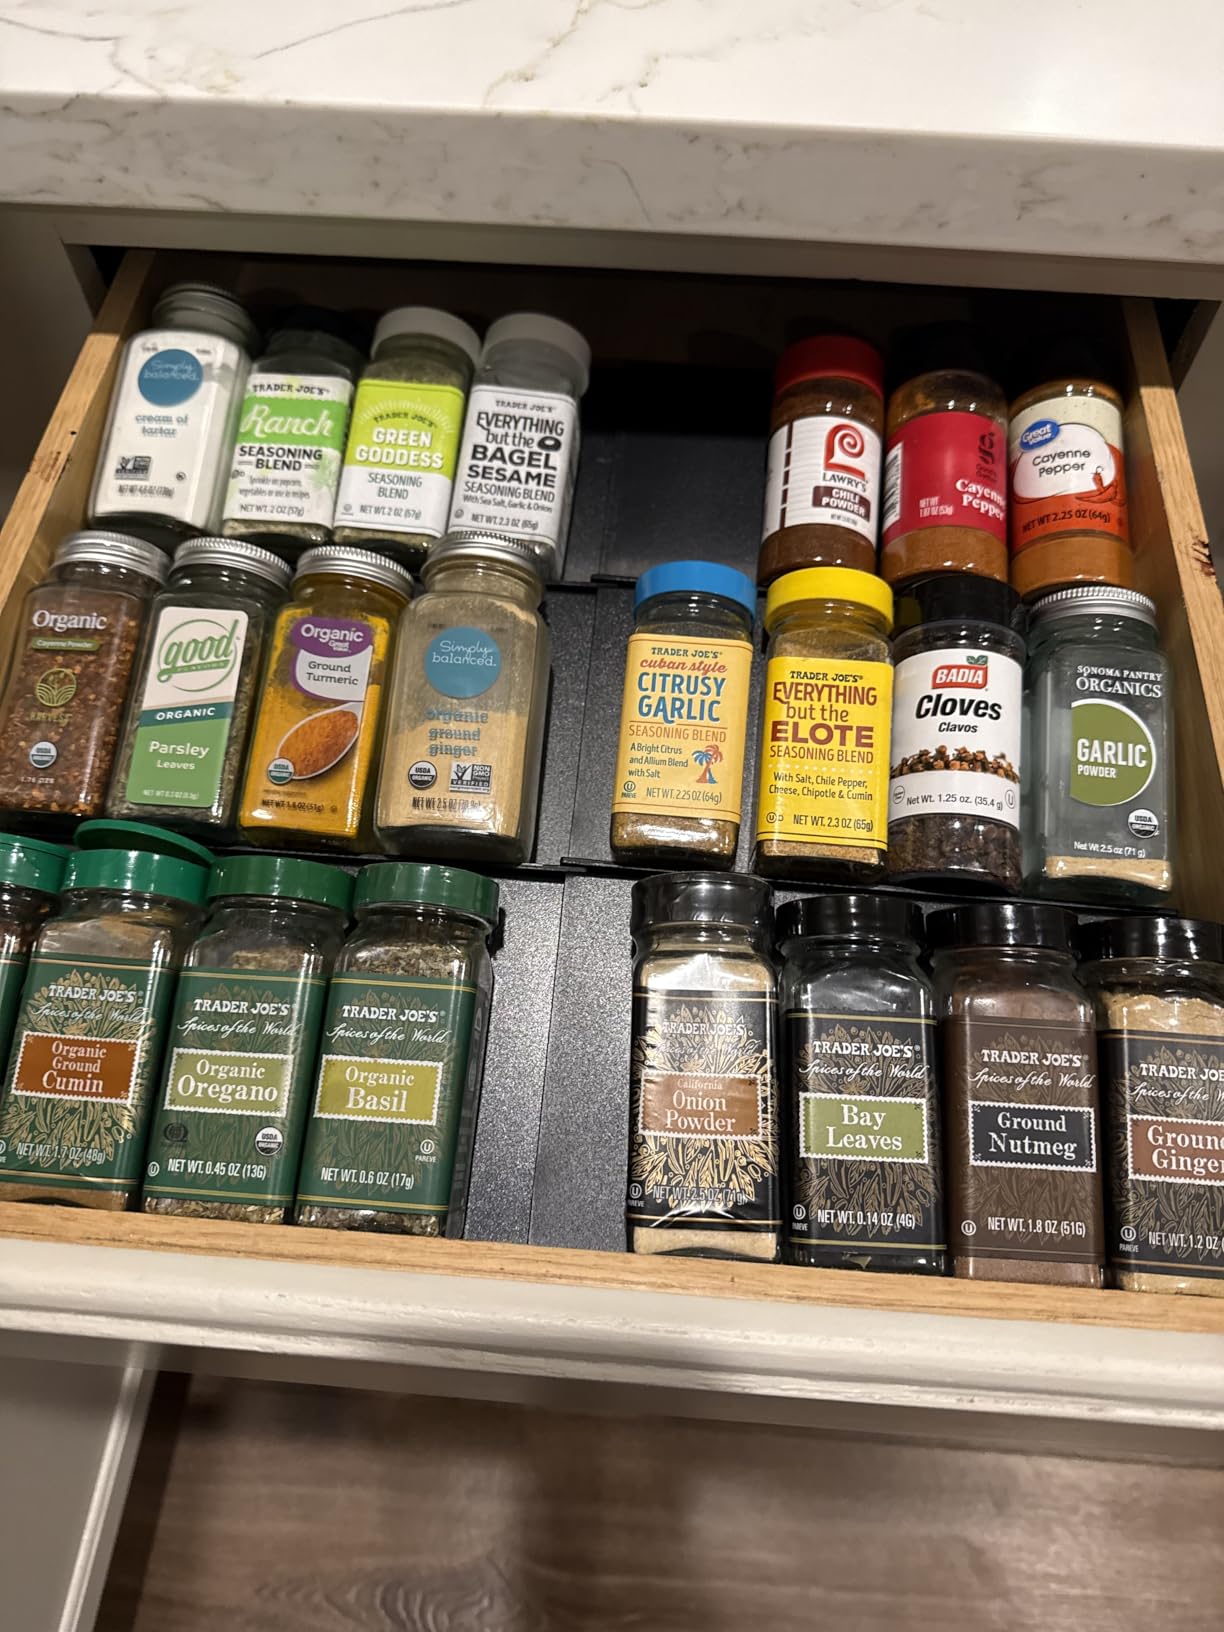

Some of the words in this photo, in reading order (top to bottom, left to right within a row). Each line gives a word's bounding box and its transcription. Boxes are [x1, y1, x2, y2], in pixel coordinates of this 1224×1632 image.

[253, 384, 293, 392] TRADER
[296, 385, 324, 395] JOE'S
[136, 415, 172, 424] cream
[176, 414, 188, 424] of
[240, 405, 334, 438] Ranch
[477, 412, 564, 436] EVERYTHING
[142, 427, 176, 437] tartar
[372, 428, 432, 448] GREEN
[486, 428, 510, 445] but
[512, 433, 534, 448] the
[240, 446, 322, 460] SEASONING
[356, 446, 444, 469] GODDESS
[472, 444, 557, 471] BAGEL
[1032, 449, 1090, 466] Cayenne
[256, 459, 302, 471] BLEND
[1039, 463, 1086, 478] Pepper
[368, 472, 422, 487] SEASONING
[468, 464, 556, 488] SESAME
[823, 472, 866, 492] LAWRY'S
[378, 487, 408, 499] BLEND
[464, 481, 521, 498] SEASONING
[523, 489, 555, 502] BLEND
[832, 488, 859, 502] CHILI
[822, 497, 866, 516] POWDER
[1024, 521, 1038, 532] NET
[1038, 514, 1051, 526] WT
[1052, 510, 1072, 521] 2.25
[1076, 510, 1086, 518] OZ
[1089, 511, 1110, 523] (64g)
[32, 609, 107, 632] Organic
[301, 623, 364, 643] Organic
[157, 618, 238, 683] good
[440, 640, 493, 658] Simply
[651, 647, 688, 657] TRADER
[691, 650, 719, 658] JOE'S
[308, 661, 351, 673] Ground
[432, 652, 496, 666] balanced.
[640, 658, 688, 670] cuban
[688, 660, 727, 676] style
[306, 672, 358, 685] Turmeric
[790, 671, 828, 680] TRADER
[832, 673, 858, 682] JOE'S
[936, 668, 983, 684] BADIA
[1077, 665, 1121, 677] SONOMA
[1123, 670, 1162, 681] PANTRY
[637, 672, 726, 697] CITRUSY
[773, 682, 877, 705] EVERYTHING
[1076, 676, 1162, 697] ORGANICS
[156, 707, 215, 720] ORGANIC
[424, 708, 489, 724] organic
[638, 695, 721, 724] GARLIC
[786, 701, 816, 720] but
[819, 704, 849, 722] the
[915, 694, 1002, 720] Cloves
[429, 728, 480, 741] ground
[629, 725, 689, 740] SEASONING
[692, 729, 726, 743] BLEND
[771, 721, 874, 748] ELOTE
[938, 722, 978, 733] Clavos
[150, 741, 209, 759] Parsley
[429, 743, 477, 758] ginger
[631, 743, 636, 751] A
[637, 743, 659, 754] Bright
[661, 745, 682, 754] Citrus
[770, 746, 834, 761] SEASONING
[837, 750, 873, 763] BLEND
[1077, 739, 1146, 768] GARLIC
[157, 760, 195, 770] Leaves
[629, 756, 643, 764] and
[644, 756, 666, 766] Allium
[668, 759, 688, 767] Blend
[629, 768, 644, 777] with
[646, 770, 660, 778] Salt
[774, 772, 793, 782] With
[795, 774, 814, 785] Salt,
[816, 775, 835, 786] Chile
[838, 777, 868, 789] Pepper,
[1078, 765, 1116, 778] POWDER
[769, 785, 800, 796] Cheese,
[802, 787, 836, 799] Chipotle
[839, 790, 844, 798] &
[847, 789, 872, 800] Cumin
[907, 796, 919, 806] Net
[921, 794, 934, 803] Wt.
[939, 794, 957, 802] 1.25
[975, 797, 995, 806] (35.4
[997, 800, 1003, 810] g)
[48, 985, 97, 999] TRADER
[100, 988, 137, 1003] JOE'S
[194, 999, 248, 1013] TRADER
[251, 1003, 291, 1016] JOE'S
[342, 1006, 397, 1020] TRADER
[399, 1009, 438, 1022] JOE'S
[327, 1023, 368, 1042] Spices
[412, 1028, 452, 1044] World
[663, 1021, 707, 1034] TRADER
[52, 1041, 107, 1059] Organic
[813, 1041, 869, 1055] TRADER
[873, 1044, 913, 1058] JOE'S
[981, 1049, 1039, 1065] TRADER
[1042, 1053, 1082, 1067] JOE'S
[52, 1057, 101, 1073] Ground
[196, 1059, 265, 1079] Organic
[1140, 1063, 1196, 1079] TRADER
[42, 1070, 104, 1093] Cumin
[345, 1066, 415, 1086] Organic
[678, 1078, 723, 1090] California
[177, 1075, 278, 1103] Oregano
[346, 1086, 407, 1113] Basil
[673, 1091, 727, 1111] Onion
[666, 1109, 736, 1132] Powder
[841, 1104, 886, 1130] Bay
[997, 1112, 1067, 1132] Ground
[826, 1126, 903, 1151] Leaves
[989, 1132, 1077, 1161] Nutmeg
[415, 1155, 436, 1163] PAREVE
[168, 1158, 186, 1173] NET
[188, 1160, 203, 1174] WT.
[206, 1161, 225, 1175] 0.45
[228, 1163, 240, 1177] OZ
[243, 1165, 267, 1181] (13G)
[321, 1167, 337, 1181] NET
[341, 1168, 357, 1183] WT.
[359, 1170, 374, 1184] 0.6
[376, 1171, 389, 1185] OZ
[391, 1172, 414, 1190] (17g)
[818, 1209, 835, 1224] NET
[838, 1210, 855, 1225] WT.
[857, 1212, 878, 1226] 0.14
[881, 1213, 893, 1226] OZ
[896, 1214, 915, 1229] (4G)
[988, 1217, 1005, 1231] NET
[1008, 1218, 1026, 1232] WT.
[1029, 1219, 1042, 1233] 1.8
[1044, 1220, 1057, 1234] OZ
[1060, 1221, 1086, 1238] (51G)
[1149, 1231, 1166, 1246] NET
[1169, 1233, 1187, 1248] WT.
[1189, 1234, 1203, 1249] 1.2
[1206, 1235, 1218, 1250] OZ
